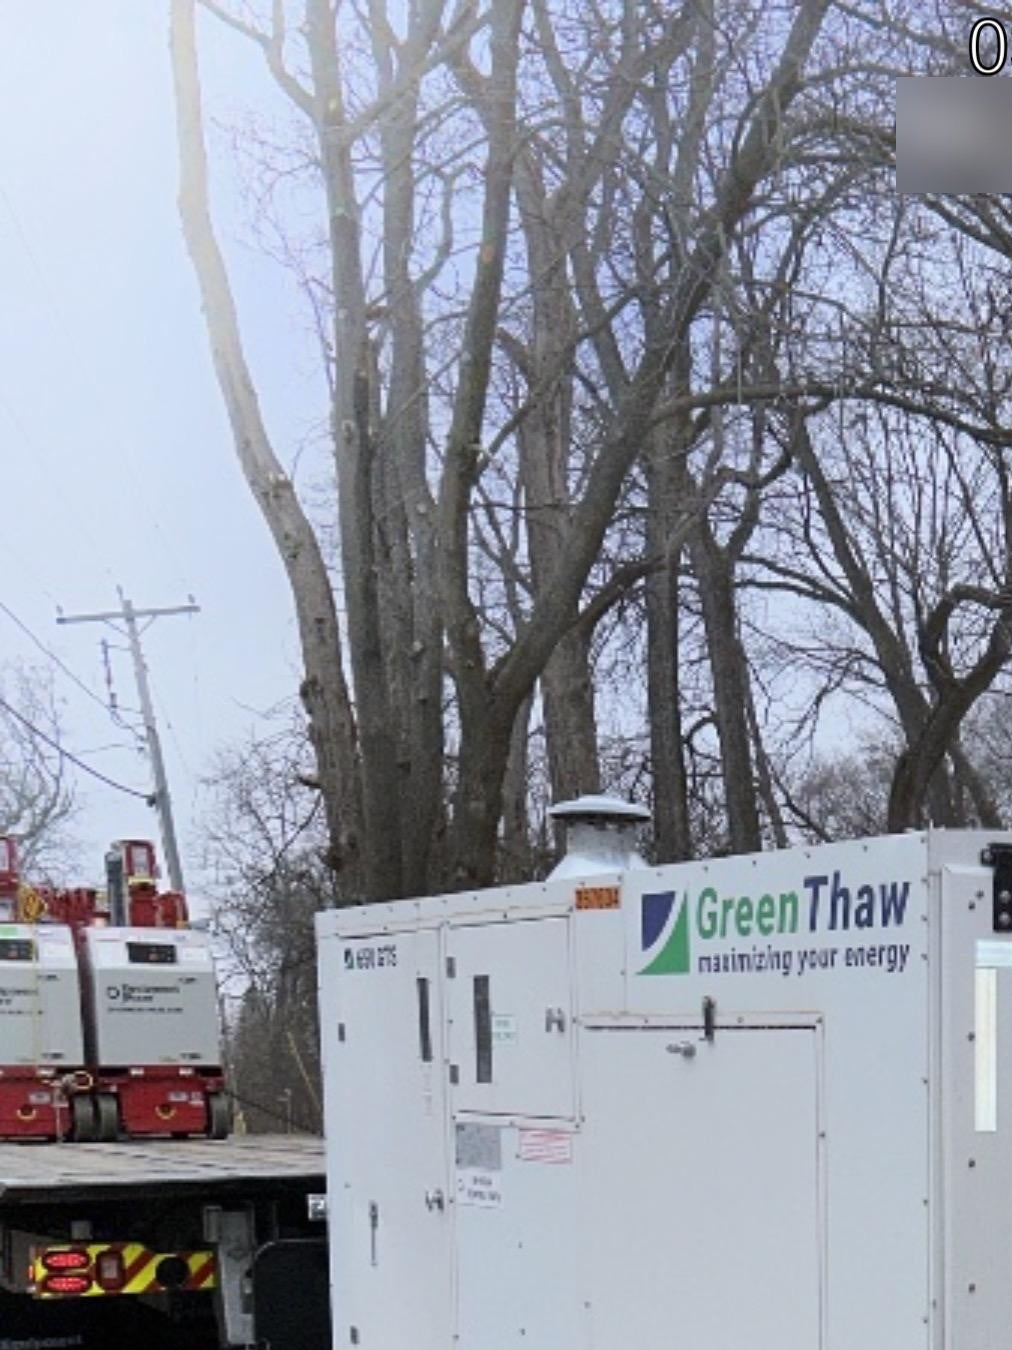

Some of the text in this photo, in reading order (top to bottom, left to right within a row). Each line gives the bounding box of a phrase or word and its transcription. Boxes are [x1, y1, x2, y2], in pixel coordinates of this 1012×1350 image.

[697, 943, 911, 977] maximizing your energy
